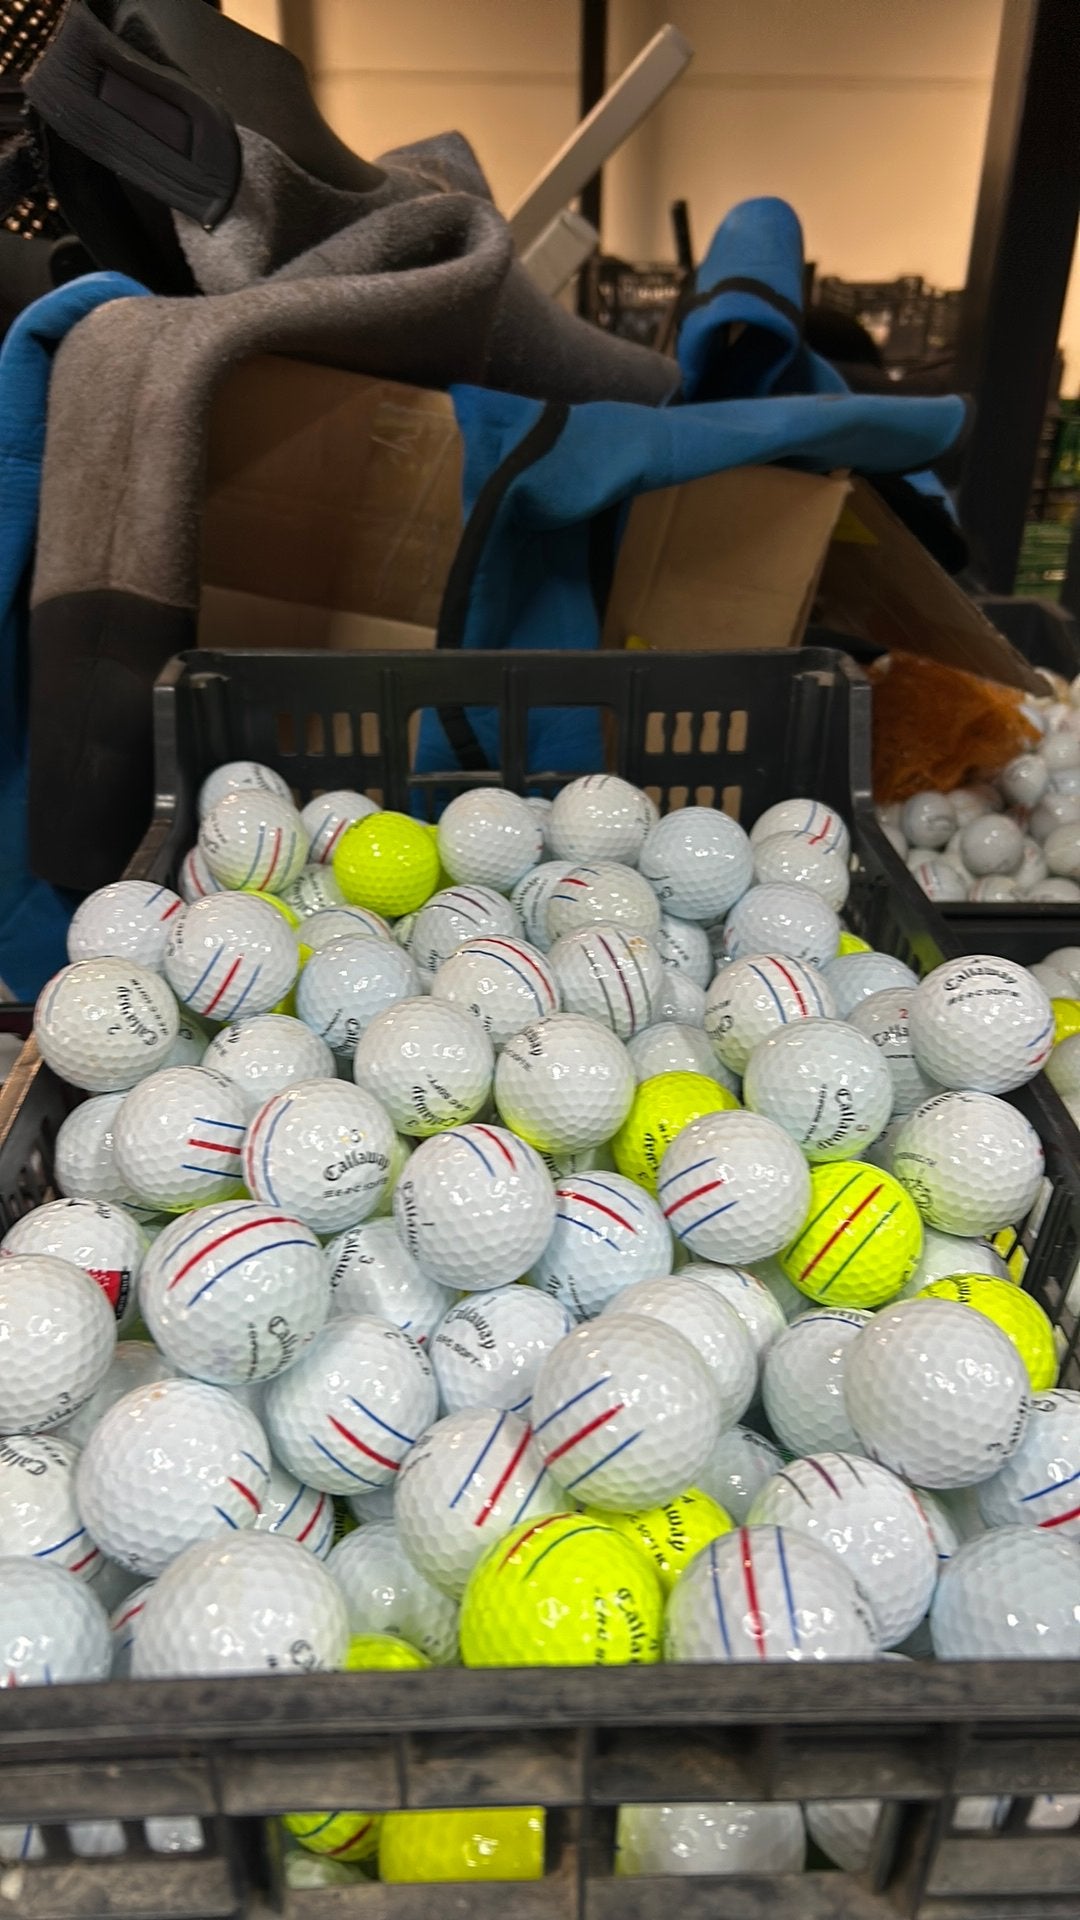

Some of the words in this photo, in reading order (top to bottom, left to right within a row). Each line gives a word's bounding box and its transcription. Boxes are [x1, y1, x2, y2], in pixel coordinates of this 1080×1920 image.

[944, 966, 1018, 991] Callaway
[117, 986, 158, 1046] Callaway
[899, 1008, 909, 1020] 2
[872, 1023, 911, 1047] Calla
[412, 1085, 459, 1127] Callaway
[816, 1088, 856, 1151] Callaway
[323, 1151, 388, 1181] Callaway
[359, 1255, 375, 1264] 3
[445, 1307, 496, 1349] Callaway
[58, 1391, 71, 1405] 3
[0, 1440, 48, 1475] Calla
[617, 1588, 646, 1663] Calla
